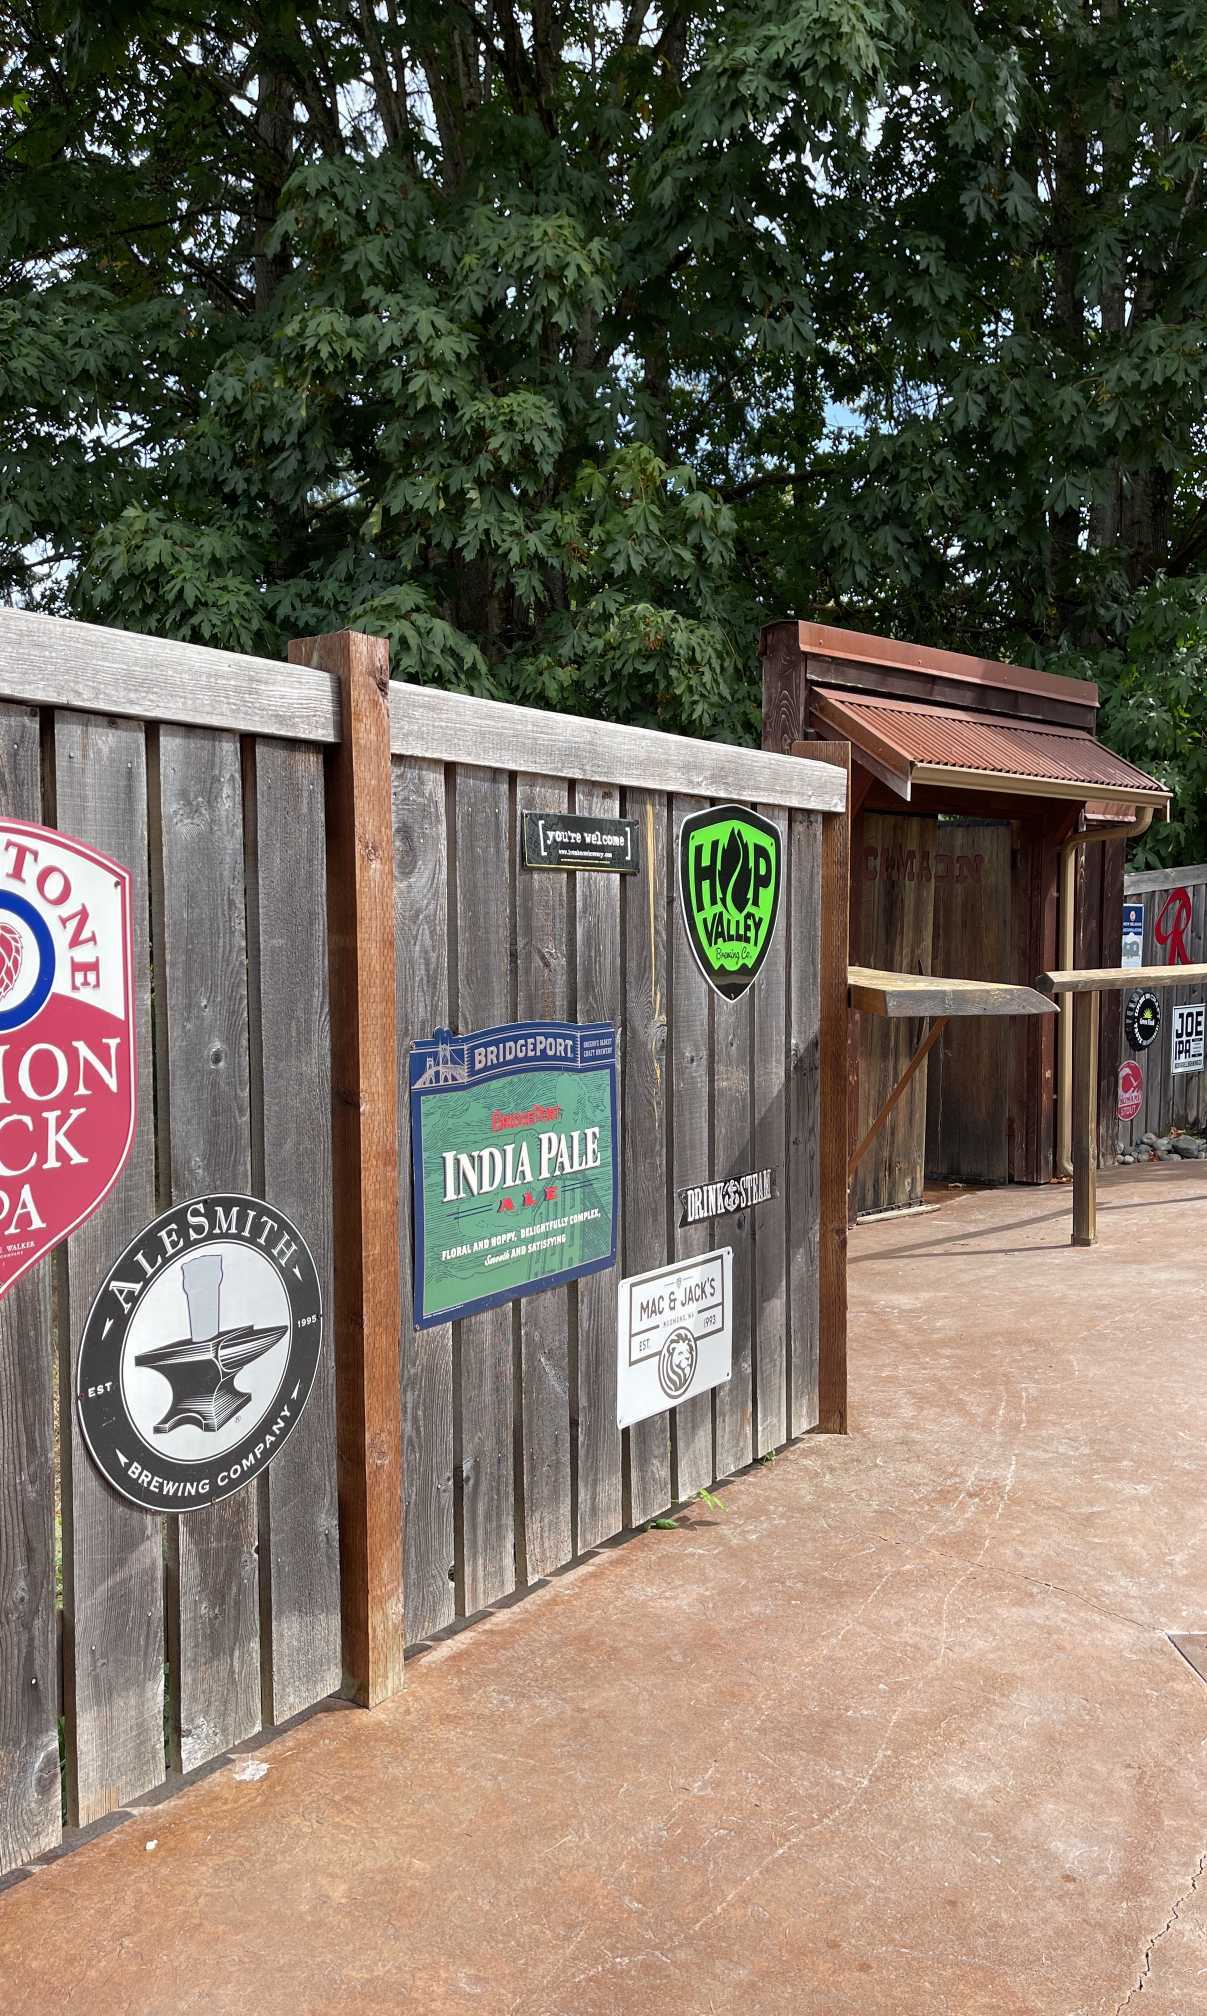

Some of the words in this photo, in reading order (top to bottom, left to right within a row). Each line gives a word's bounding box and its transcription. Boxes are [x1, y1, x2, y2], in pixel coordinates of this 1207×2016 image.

[546, 831, 582, 845] you're
[583, 831, 625, 846] welcome
[694, 827, 772, 916] HOP
[702, 912, 763, 948] VALLEY
[1175, 1011, 1204, 1039] JOE
[474, 1035, 575, 1070] BRIDGEPORT
[1175, 1039, 1191, 1060] IPA
[442, 1141, 533, 1202] INDIA
[538, 1126, 601, 1180] PALE
[687, 1182, 725, 1222] DRINK
[740, 1169, 772, 1208] STEAM
[6, 1240, 36, 1252] WALKER
[442, 1247, 471, 1261] FLORAL
[472, 1239, 490, 1252] AND
[520, 1216, 569, 1239] DELIGHTFULLY
[511, 1245, 526, 1259] AND
[528, 1234, 567, 1254] SATISFYING
[109, 1203, 298, 1314] ALESMITH
[639, 1294, 665, 1322] MAC
[668, 1291, 677, 1312] &
[681, 1277, 716, 1308] JACK'S
[297, 1314, 318, 1328] 1995
[88, 1381, 114, 1399] EST
[128, 1461, 210, 1497] BREWING
[217, 1405, 292, 1486] COMPANY
